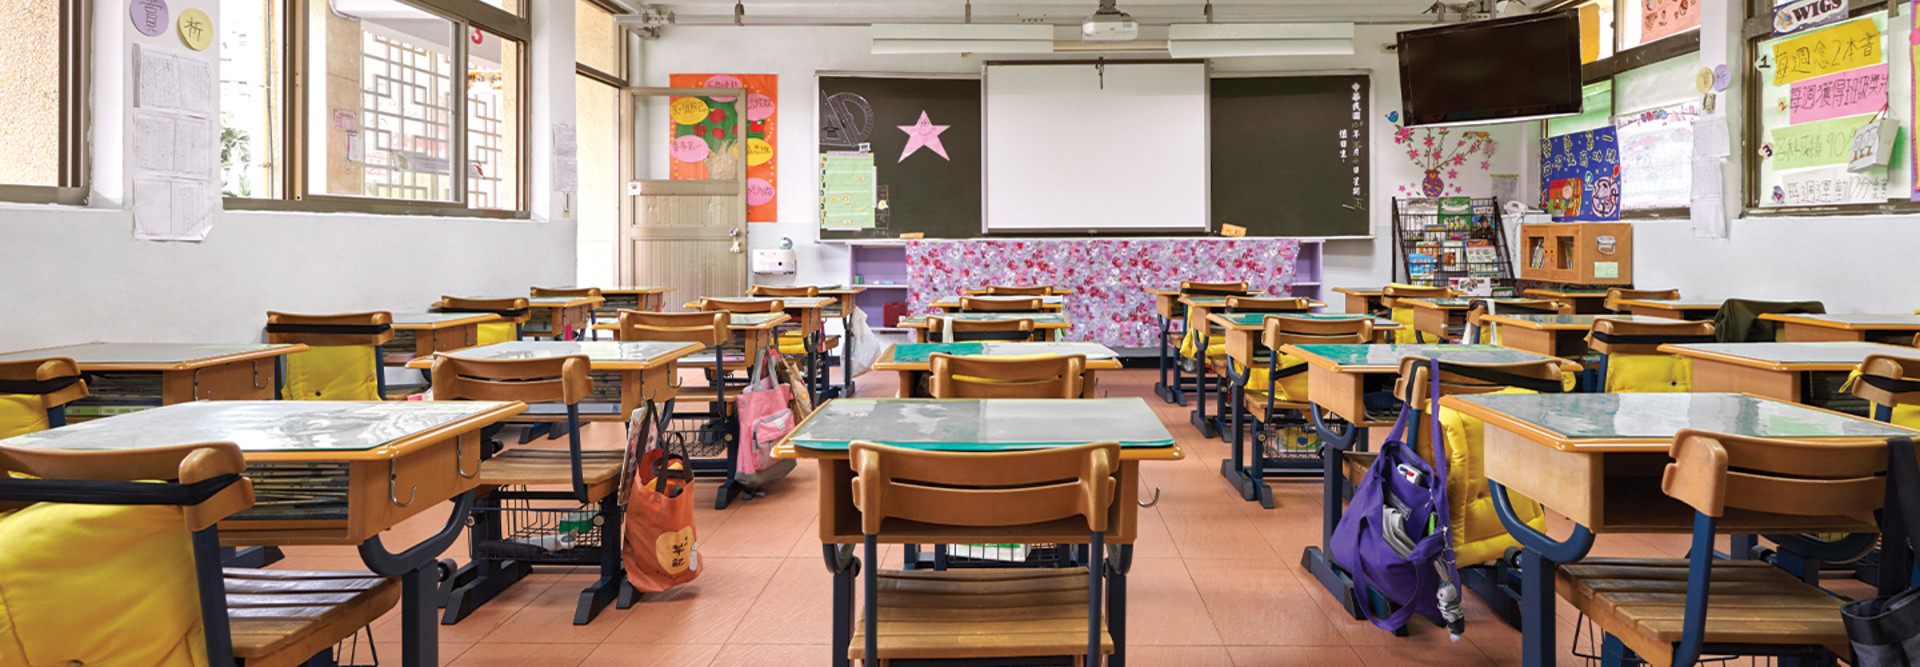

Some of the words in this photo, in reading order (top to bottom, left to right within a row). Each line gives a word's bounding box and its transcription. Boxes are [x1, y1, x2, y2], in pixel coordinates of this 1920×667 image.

[184, 16, 203, 42] 析
[1758, 55, 1770, 68] 1
[1776, 32, 1876, 80] 每週念2本書
[1764, 145, 1773, 158] 3
[1585, 170, 1594, 191] 2
